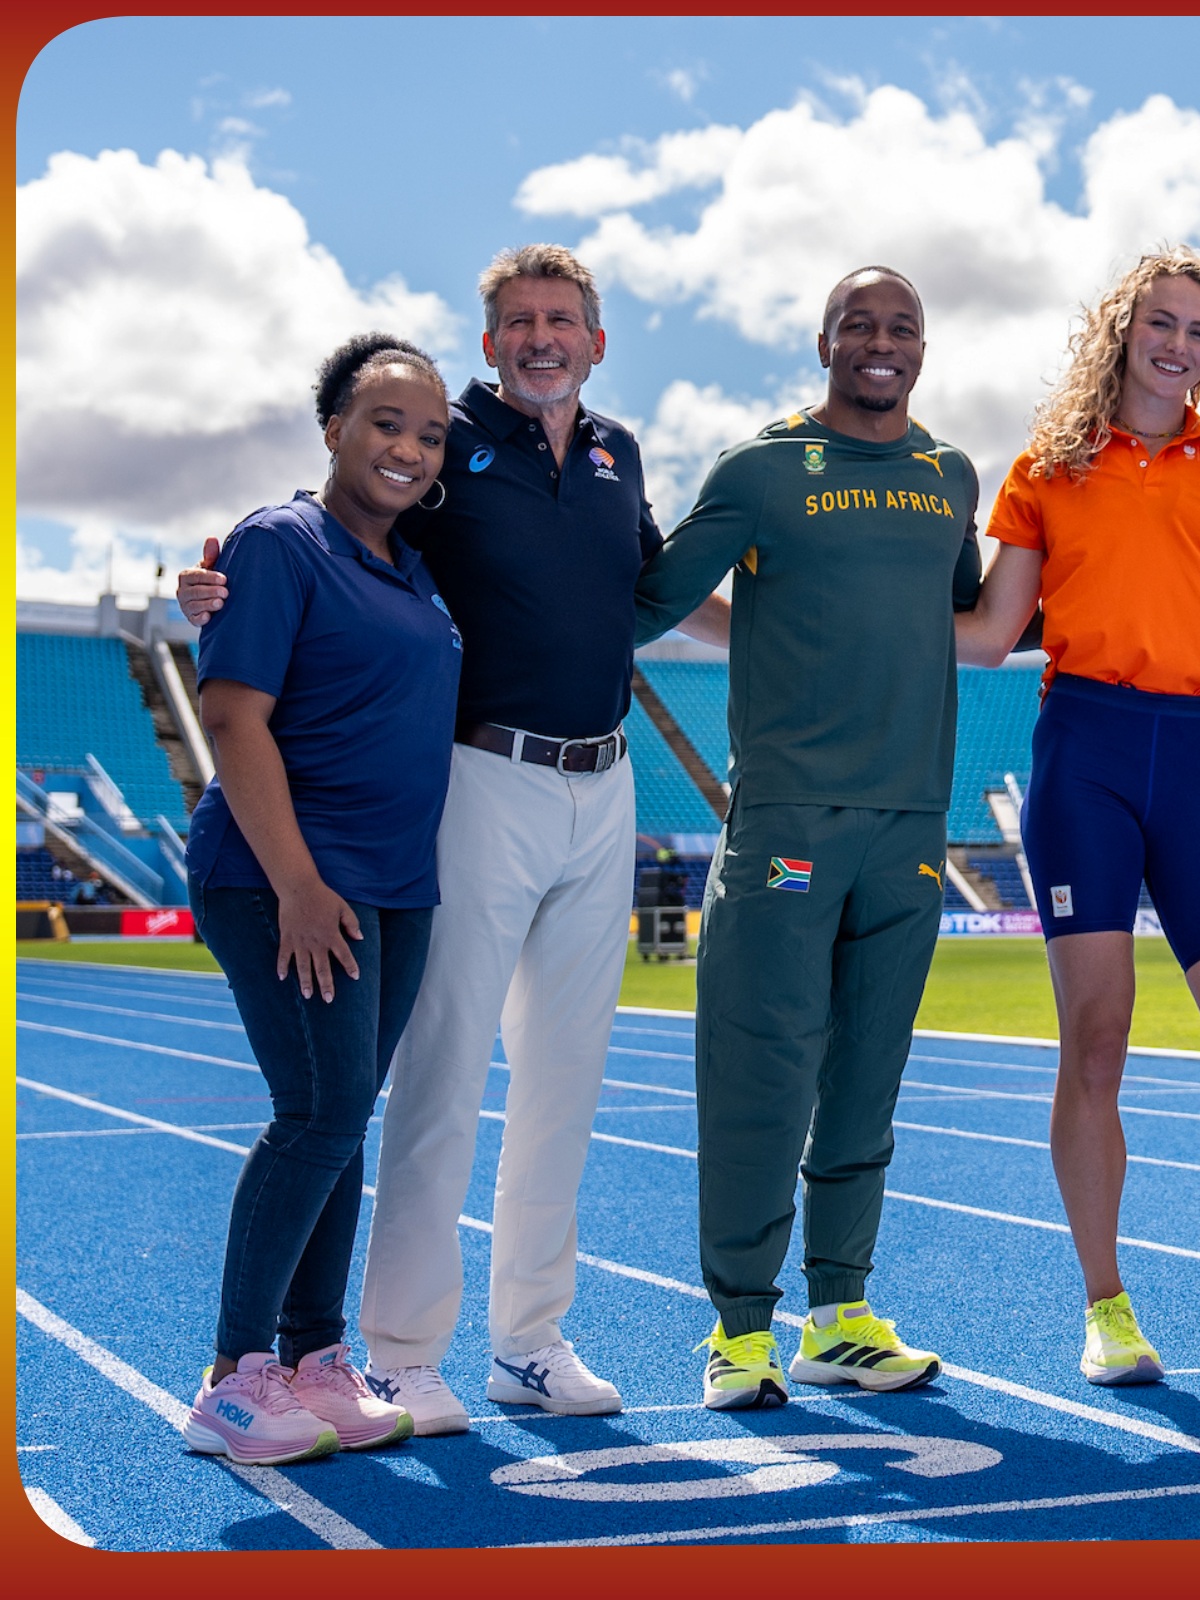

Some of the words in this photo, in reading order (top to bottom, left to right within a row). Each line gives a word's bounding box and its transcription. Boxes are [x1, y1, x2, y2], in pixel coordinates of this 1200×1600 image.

[805, 489, 877, 516] SOUTH
[886, 490, 955, 519] AFRICA
[952, 913, 1003, 932] TDK
[215, 1398, 255, 1431] HOKA
[489, 1433, 1004, 1502] 6
